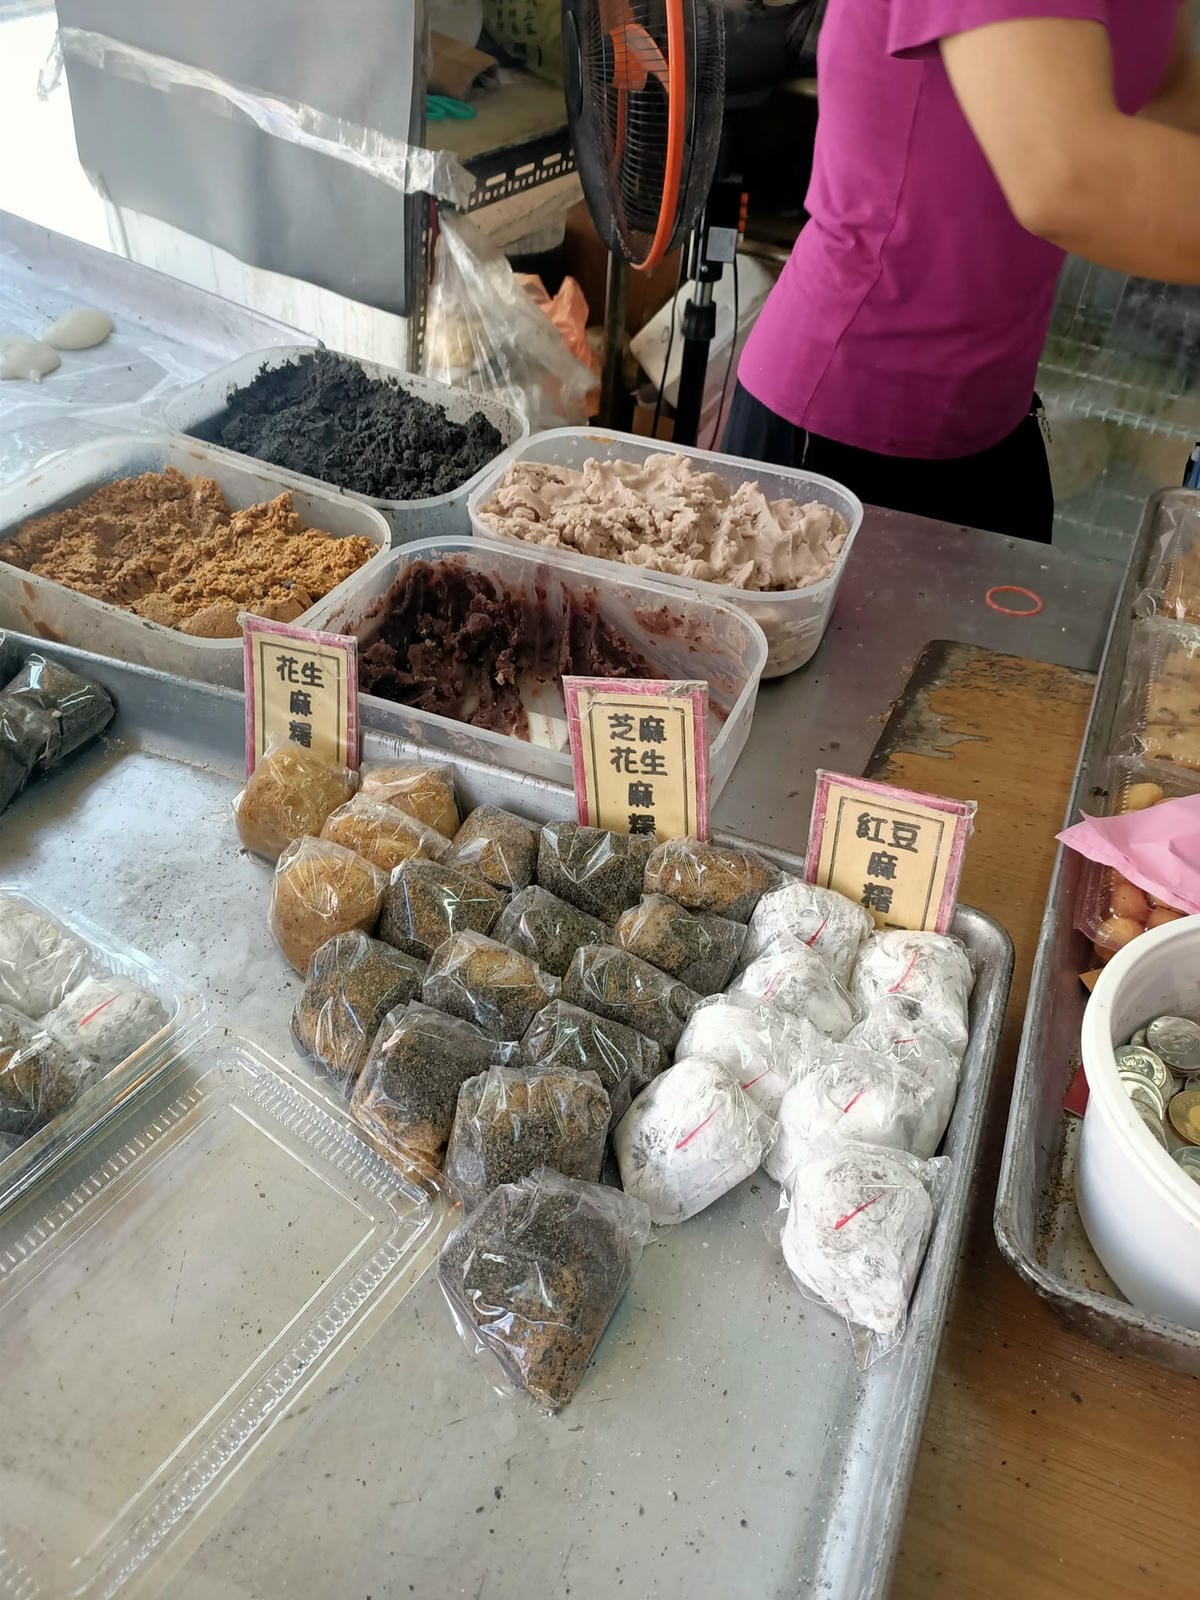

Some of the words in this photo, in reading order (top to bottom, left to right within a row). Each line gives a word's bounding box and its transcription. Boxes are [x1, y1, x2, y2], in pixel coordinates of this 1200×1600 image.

[276, 655, 325, 688] 花生
[608, 713, 667, 744] 芝麻
[610, 746, 668, 776] 花生
[856, 812, 921, 853] 紅豆
